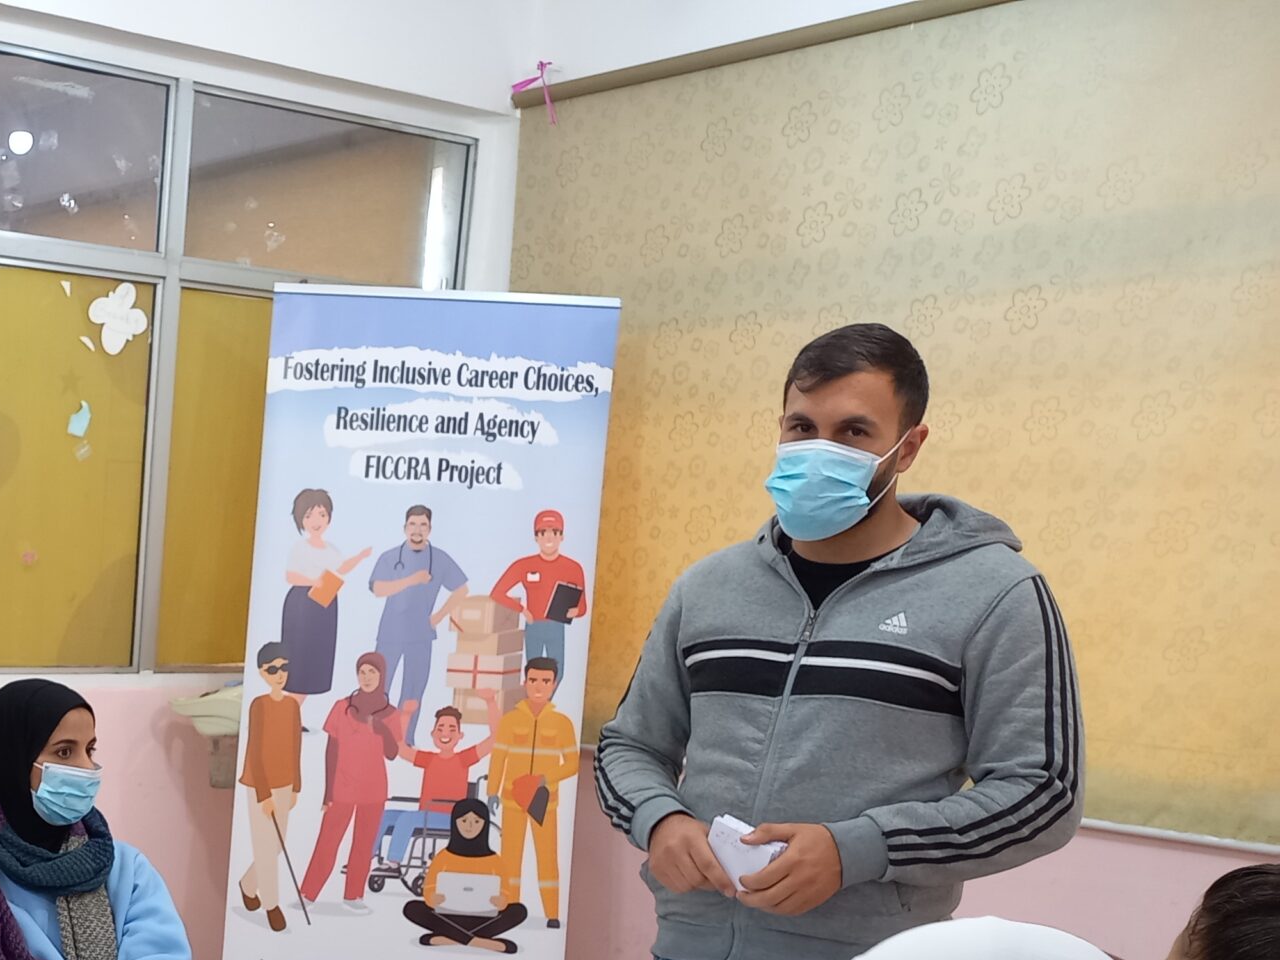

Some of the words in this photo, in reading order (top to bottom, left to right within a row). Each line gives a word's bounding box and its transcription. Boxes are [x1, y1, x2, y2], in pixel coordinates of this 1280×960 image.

[283, 356, 366, 388] Fostering
[372, 359, 451, 387] Inclusive
[457, 363, 518, 389] Career
[523, 366, 599, 397] Choices,
[335, 406, 429, 434] Resilience
[435, 412, 468, 436] and
[473, 412, 540, 443] Agency
[364, 455, 431, 481] FICCRA
[437, 458, 503, 489] Project
